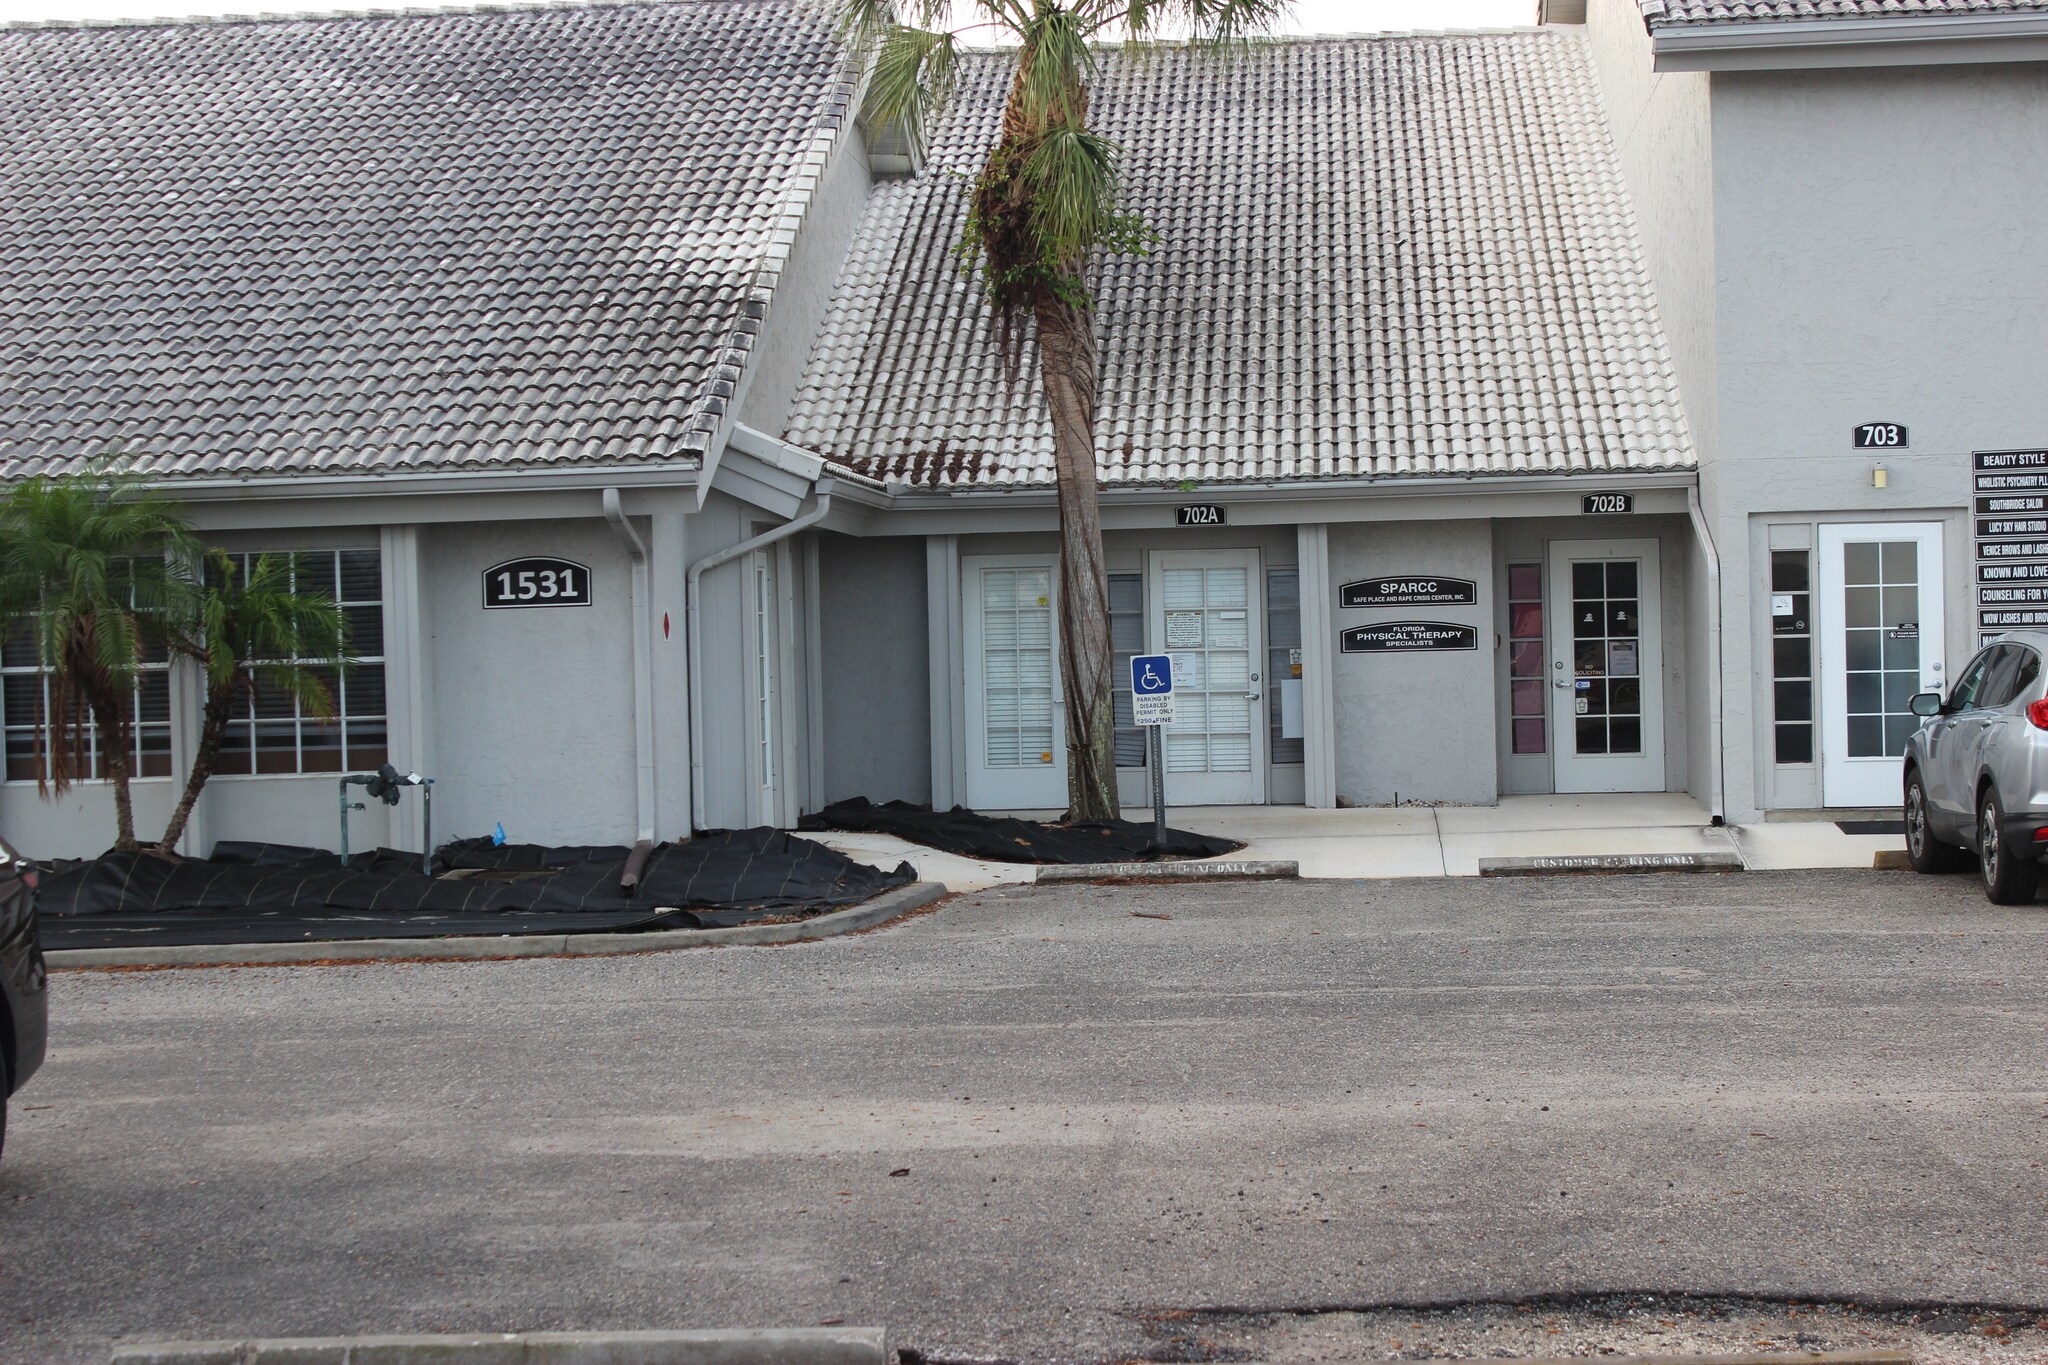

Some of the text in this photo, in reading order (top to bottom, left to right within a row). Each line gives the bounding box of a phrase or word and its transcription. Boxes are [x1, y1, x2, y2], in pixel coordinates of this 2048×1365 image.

[1862, 425, 1899, 446] 703
[1983, 453, 2046, 467] BEAUTY STYLE
[1977, 476, 2006, 488] WHOLISTIC
[2006, 475, 2038, 488] PSYCHIATRY
[1590, 495, 1625, 512] 702B
[1989, 498, 2043, 511] SOUTHBRIDGE SALON
[1183, 506, 1218, 524] 702A
[1988, 520, 2047, 533] LUCY SKY HAIR STUDIO
[1982, 545, 2001, 556] VENICE
[2001, 544, 2021, 555] BROWS
[2021, 544, 2032, 555] AND
[1983, 567, 2011, 579] KNOWN
[2012, 566, 2028, 578] AND
[497, 568, 578, 600] 1531
[1380, 582, 1437, 594] SPARCC
[1981, 589, 2026, 601] COUNSELING
[2027, 588, 2041, 600] FOR
[1982, 613, 1999, 624] WOW
[1999, 612, 2021, 624] LASHES
[2021, 612, 2034, 623] AND
[1356, 630, 1463, 641] PHYSICAL THERAPY
[1386, 639, 1434, 647] SPECIALISTS
